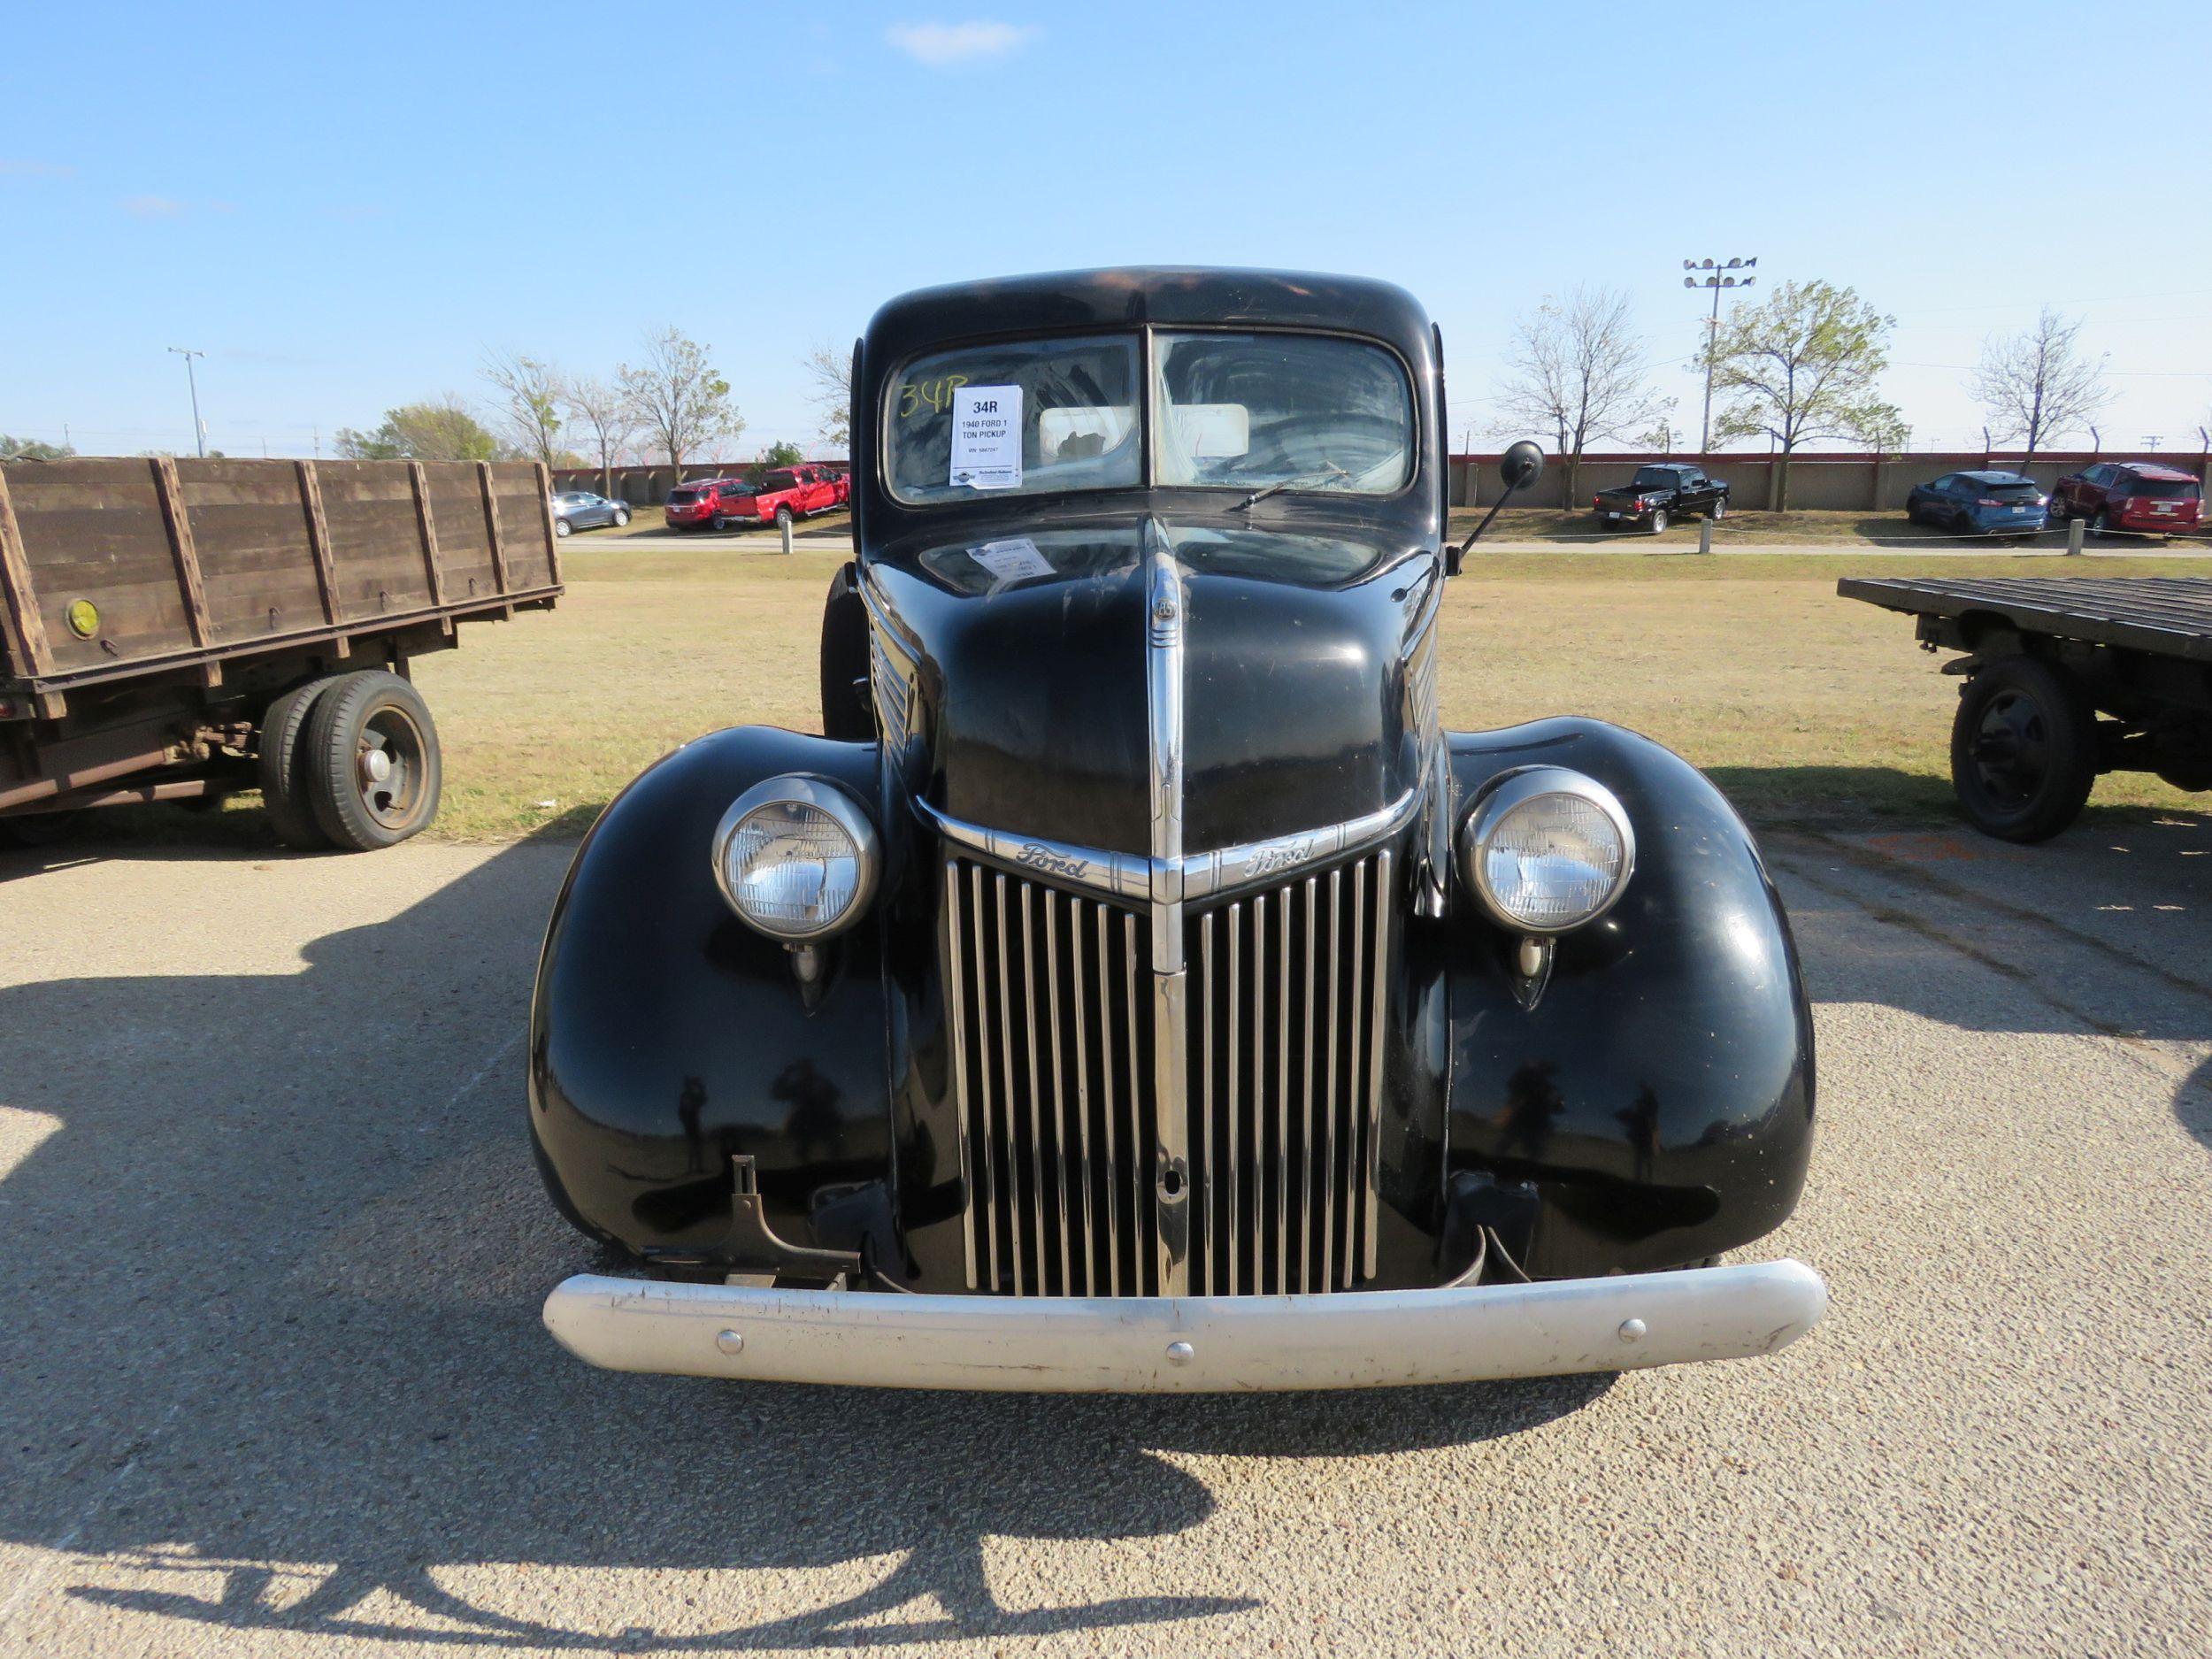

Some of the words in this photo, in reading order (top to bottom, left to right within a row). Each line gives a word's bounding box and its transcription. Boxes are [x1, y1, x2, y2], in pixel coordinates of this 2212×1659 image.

[972, 400, 998, 414] 34R
[1016, 842, 1089, 879] Ford
[1244, 839, 1315, 878] Ford
